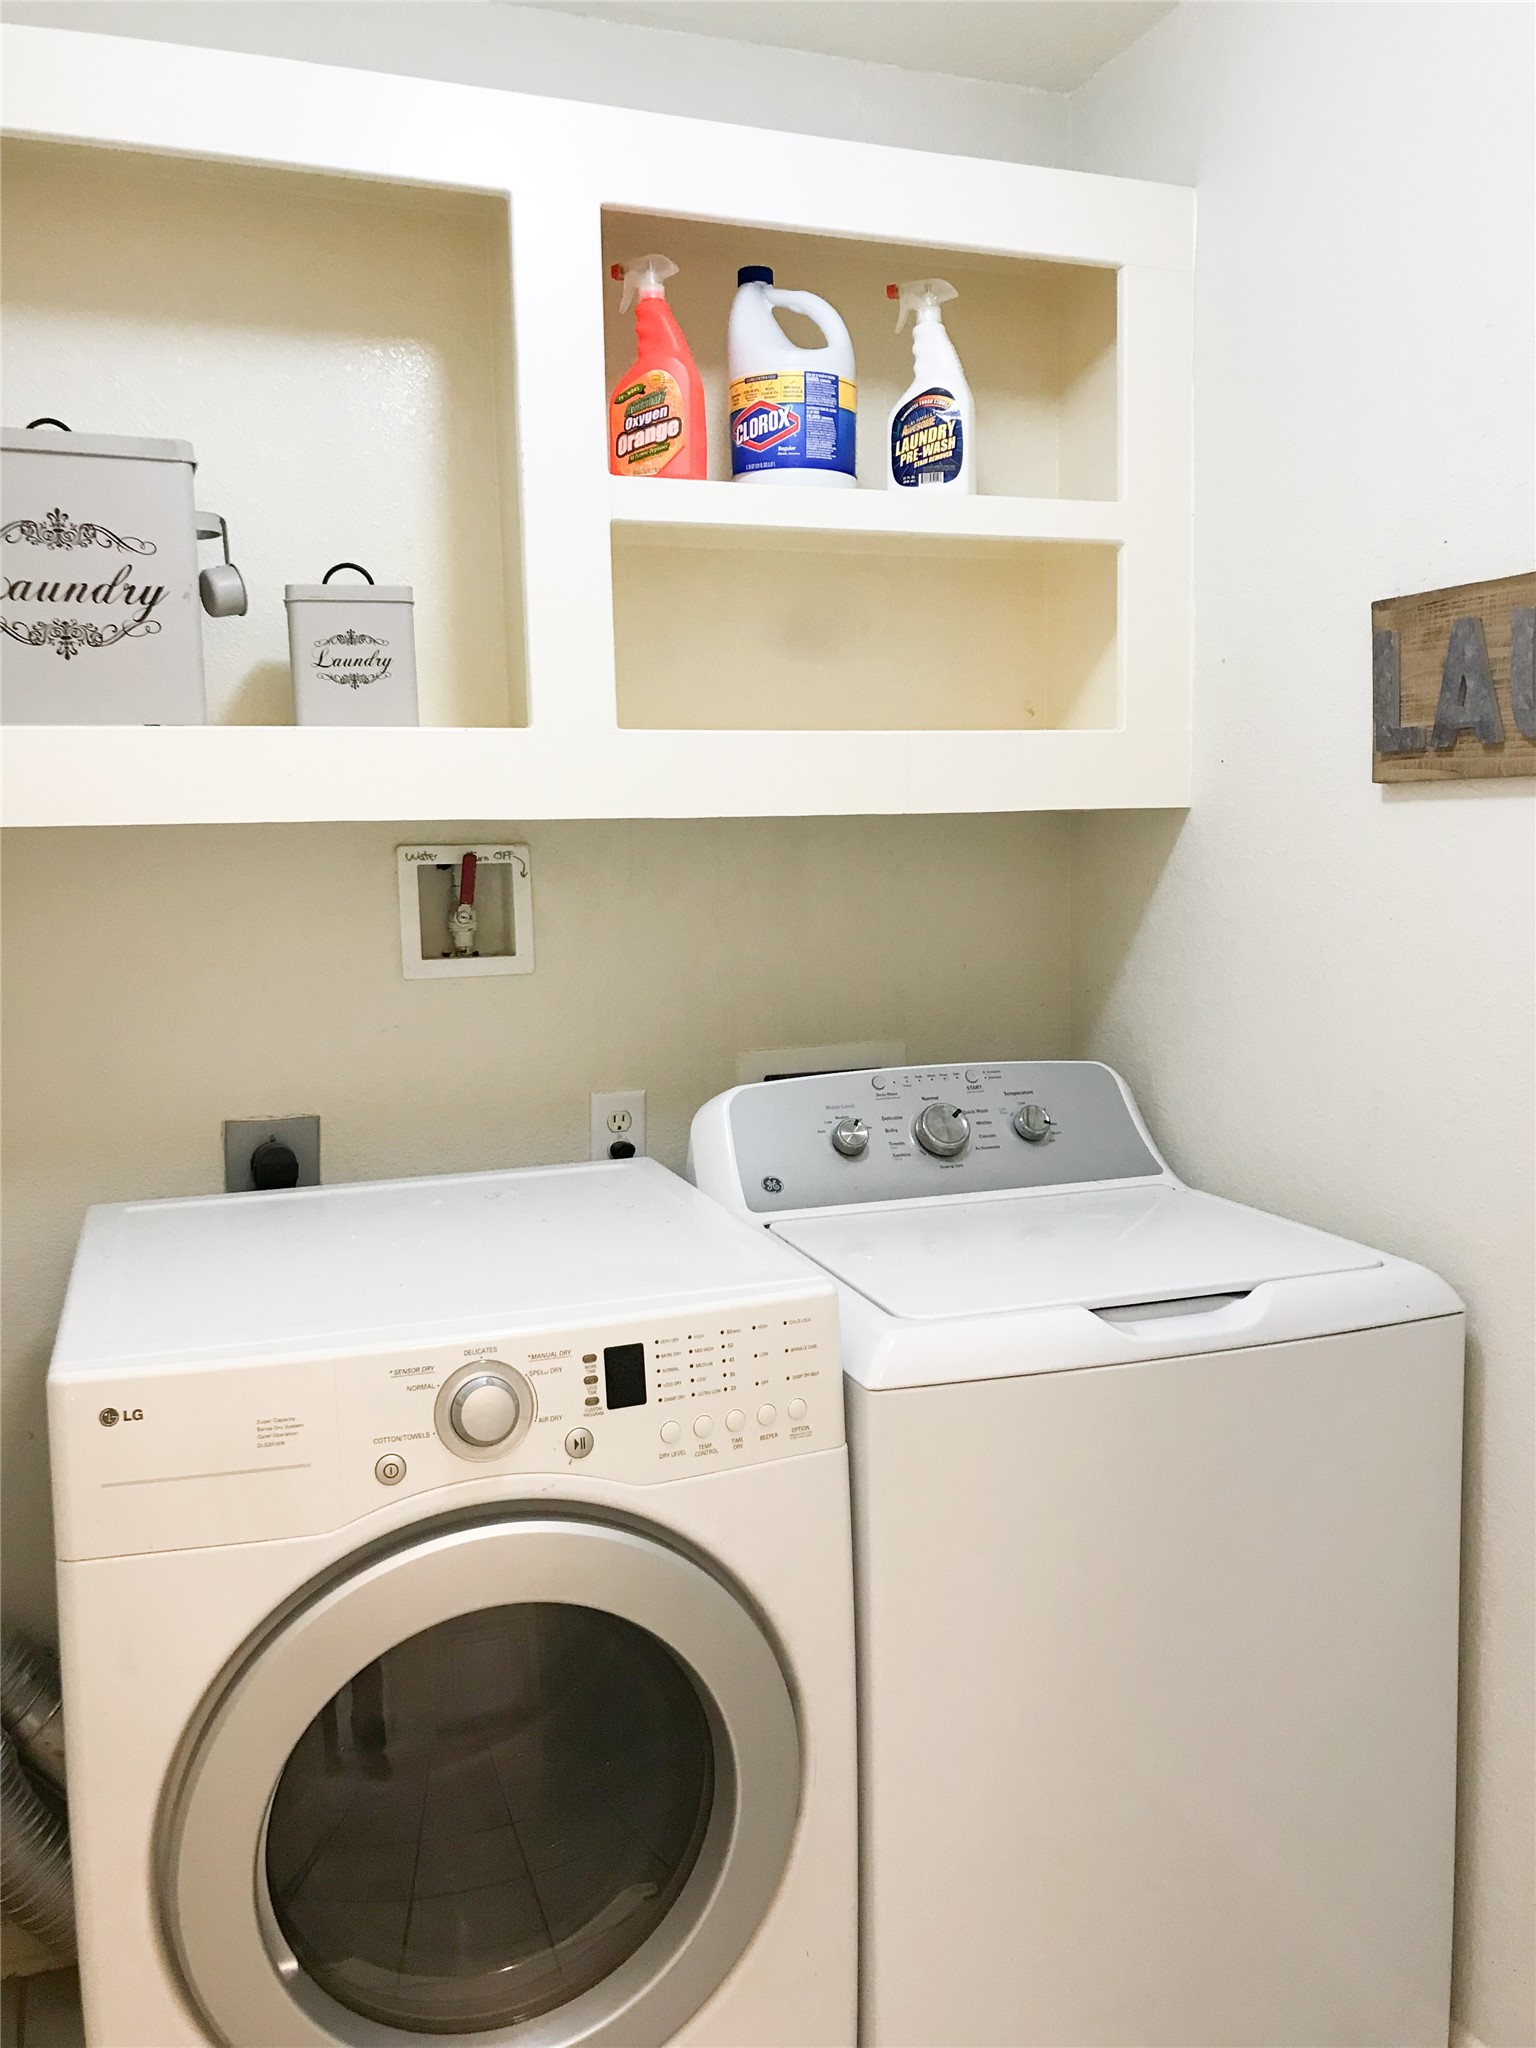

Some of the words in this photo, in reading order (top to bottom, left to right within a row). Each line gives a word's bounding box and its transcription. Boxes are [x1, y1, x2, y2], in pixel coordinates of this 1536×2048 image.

[625, 406, 668, 431] Oxygen
[736, 405, 792, 446] CLOROX
[616, 418, 680, 456] Orange
[896, 420, 956, 456] LAUNDRY
[900, 436, 956, 468] PRE-WASH
[914, 458, 928, 468] STAIN
[311, 648, 393, 674] Laundry
[404, 850, 438, 862] Water
[464, 1346, 498, 1356] DELICATES
[531, 1351, 557, 1359] MANUAL
[123, 1409, 144, 1421] LG
[373, 1432, 430, 1444] COTTON/TOWELS
[760, 1433, 778, 1441] BEEPER
[695, 1449, 719, 1457] CONTROL
